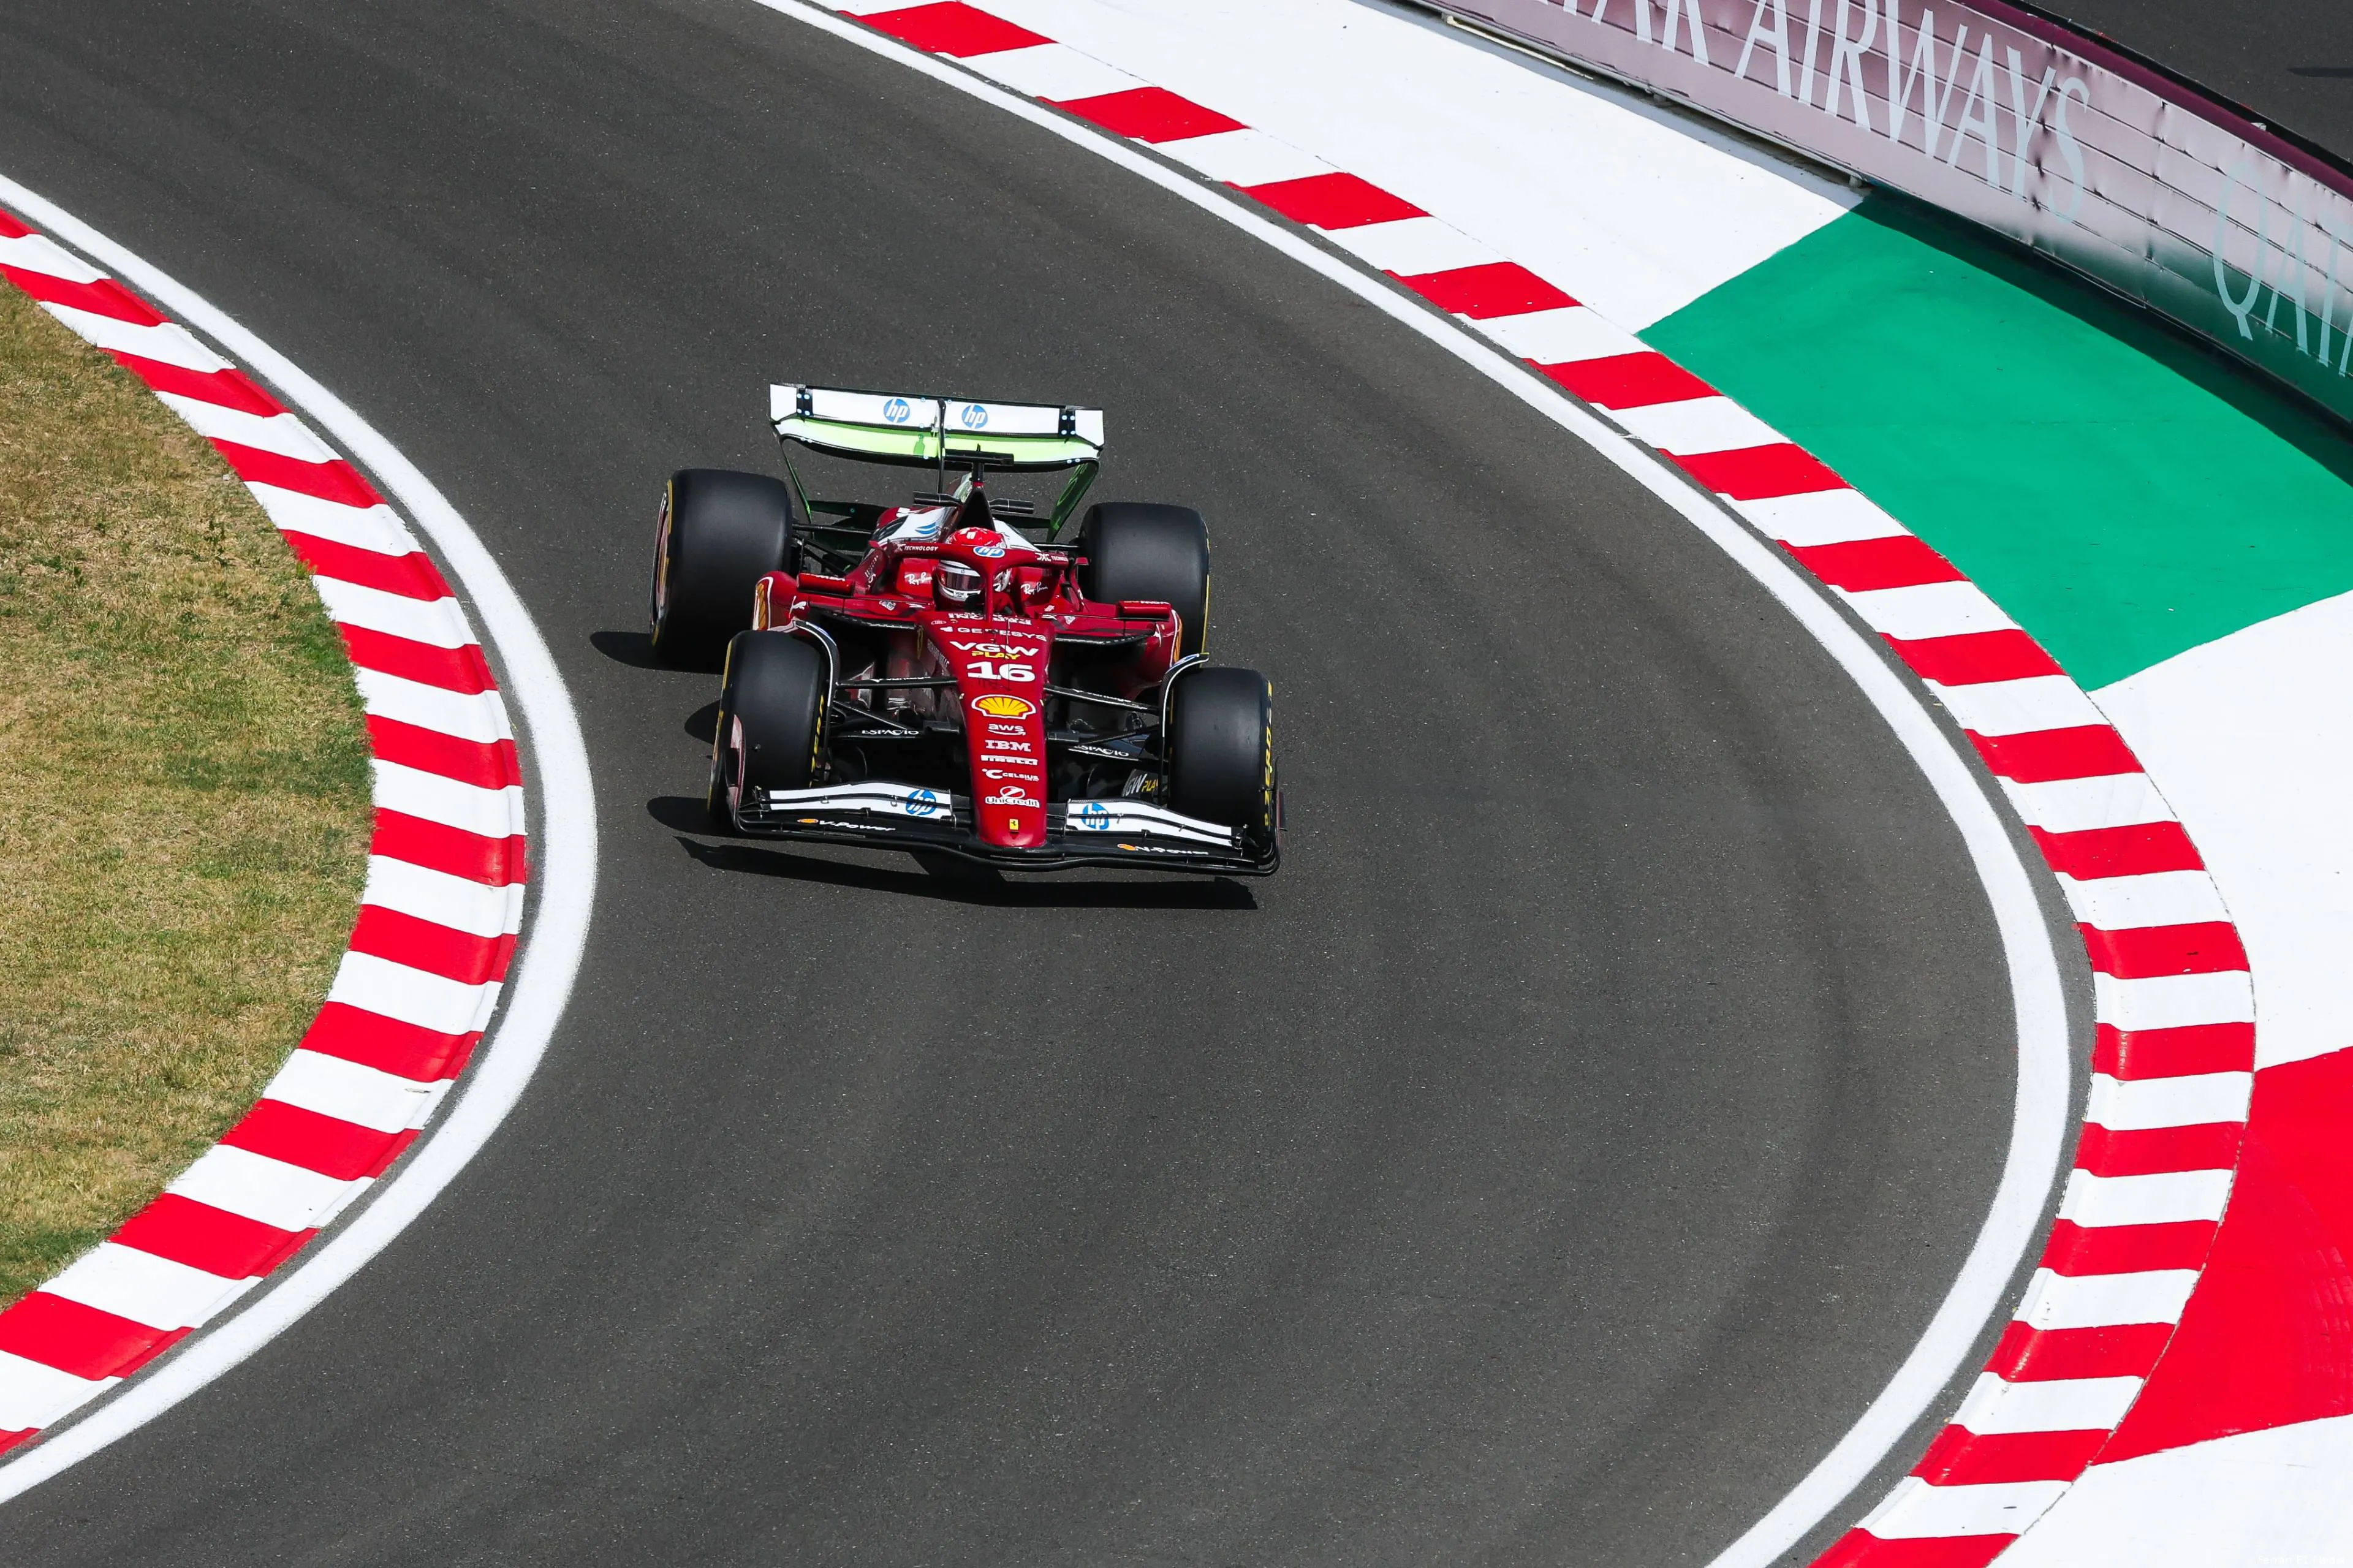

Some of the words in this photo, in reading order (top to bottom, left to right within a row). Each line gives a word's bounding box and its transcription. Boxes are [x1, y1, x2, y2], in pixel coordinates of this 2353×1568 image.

[1733, 0, 2090, 222] AIRWAYS
[885, 398, 908, 423] hp
[964, 404, 987, 429] hp
[977, 546, 1003, 558] hp
[904, 572, 933, 585] Ray-Ban
[1020, 582, 1048, 595] Ray-Ban
[950, 641, 1039, 656] VGW
[972, 651, 1020, 660] PLAY
[967, 661, 1036, 682] 16
[985, 740, 1031, 752] IBM
[906, 789, 936, 816] hp
[986, 797, 1040, 808] UniCredit
[1085, 803, 1108, 830] hp
[819, 820, 896, 831] V-Power
